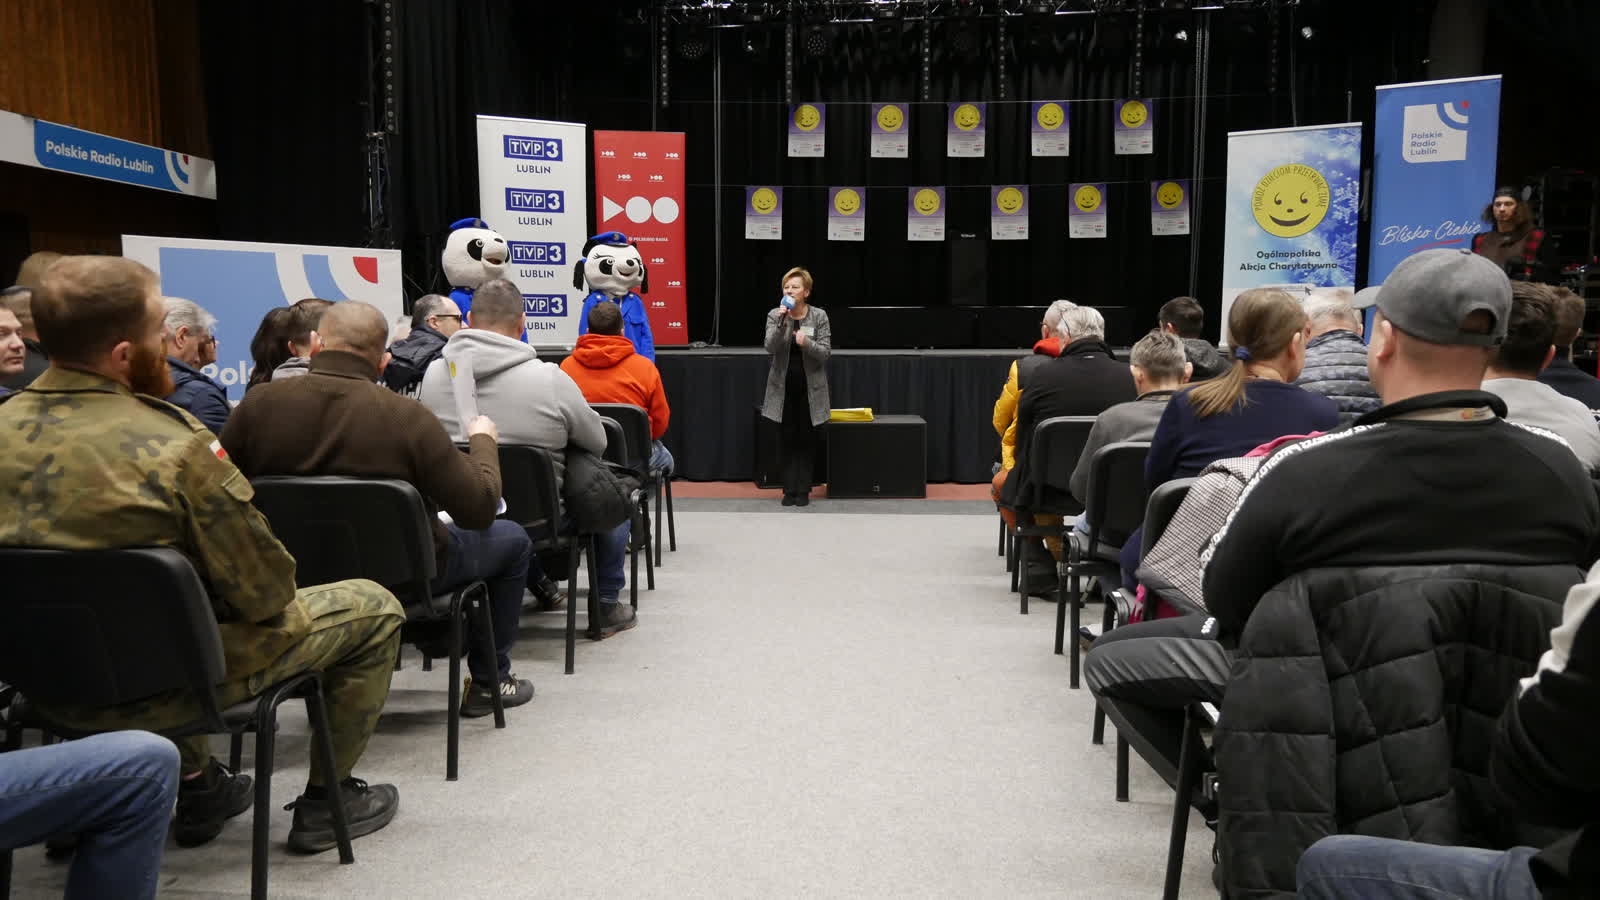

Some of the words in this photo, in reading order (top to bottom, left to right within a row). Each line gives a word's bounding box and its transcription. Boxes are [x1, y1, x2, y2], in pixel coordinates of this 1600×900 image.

[45, 139, 89, 161] Polskie
[90, 150, 122, 167] Radio
[123, 157, 155, 174] Lublin
[516, 164, 551, 174] LUBLIN
[518, 216, 552, 226] LUBLIN
[1378, 225, 1433, 246] Blisko
[1434, 220, 1481, 240] Ciebie
[1256, 249, 1321, 259] Ogólnopolska
[1239, 262, 1266, 272] Akcja
[1268, 261, 1338, 271] Charytatywna
[520, 269, 554, 278] LUBLIN
[527, 322, 556, 330] UBLIN
